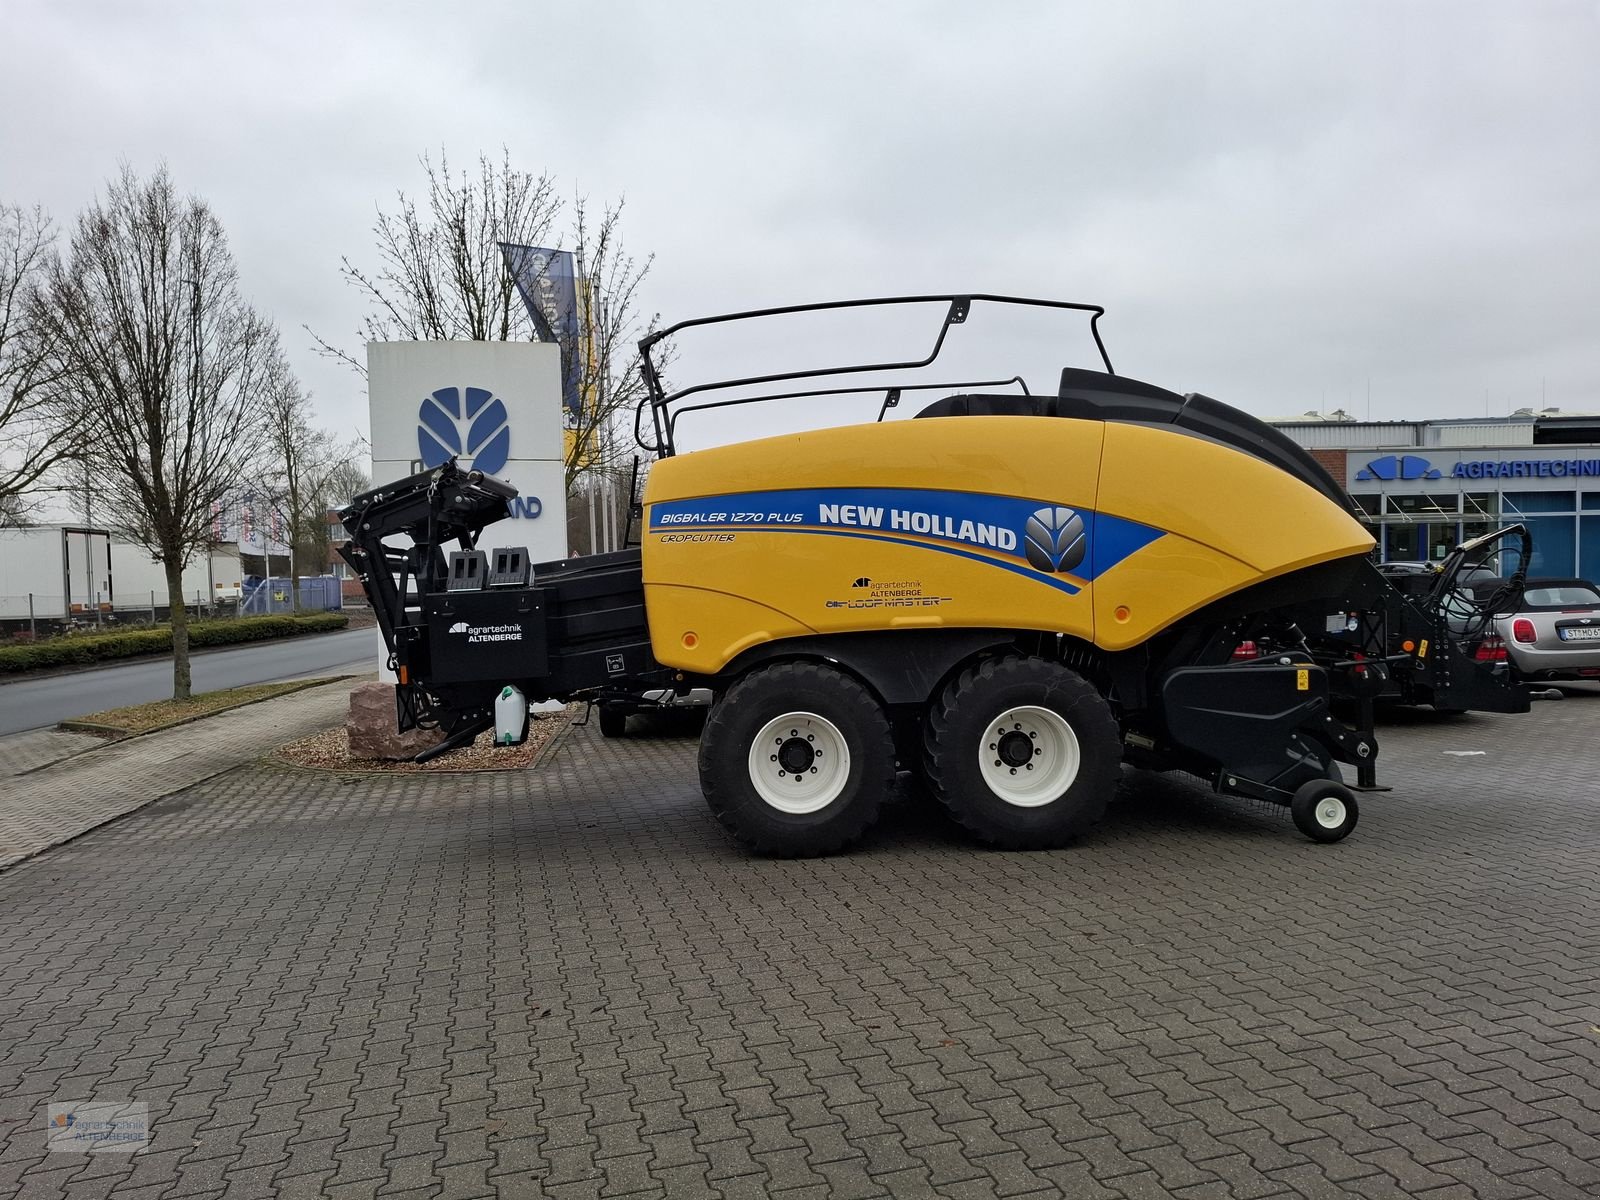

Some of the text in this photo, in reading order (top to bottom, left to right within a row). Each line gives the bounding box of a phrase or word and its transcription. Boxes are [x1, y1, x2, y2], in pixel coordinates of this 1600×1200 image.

[660, 503, 1017, 551] BIGBALER 1270 PLUS NEW HOLLAND
[660, 534, 736, 543] CROPCUTTER
[870, 580, 922, 590] agrartechnik
[870, 589, 922, 598] ALTENBERGE
[469, 624, 522, 635] agrartechnik
[468, 633, 522, 643] ALTENBERGE
